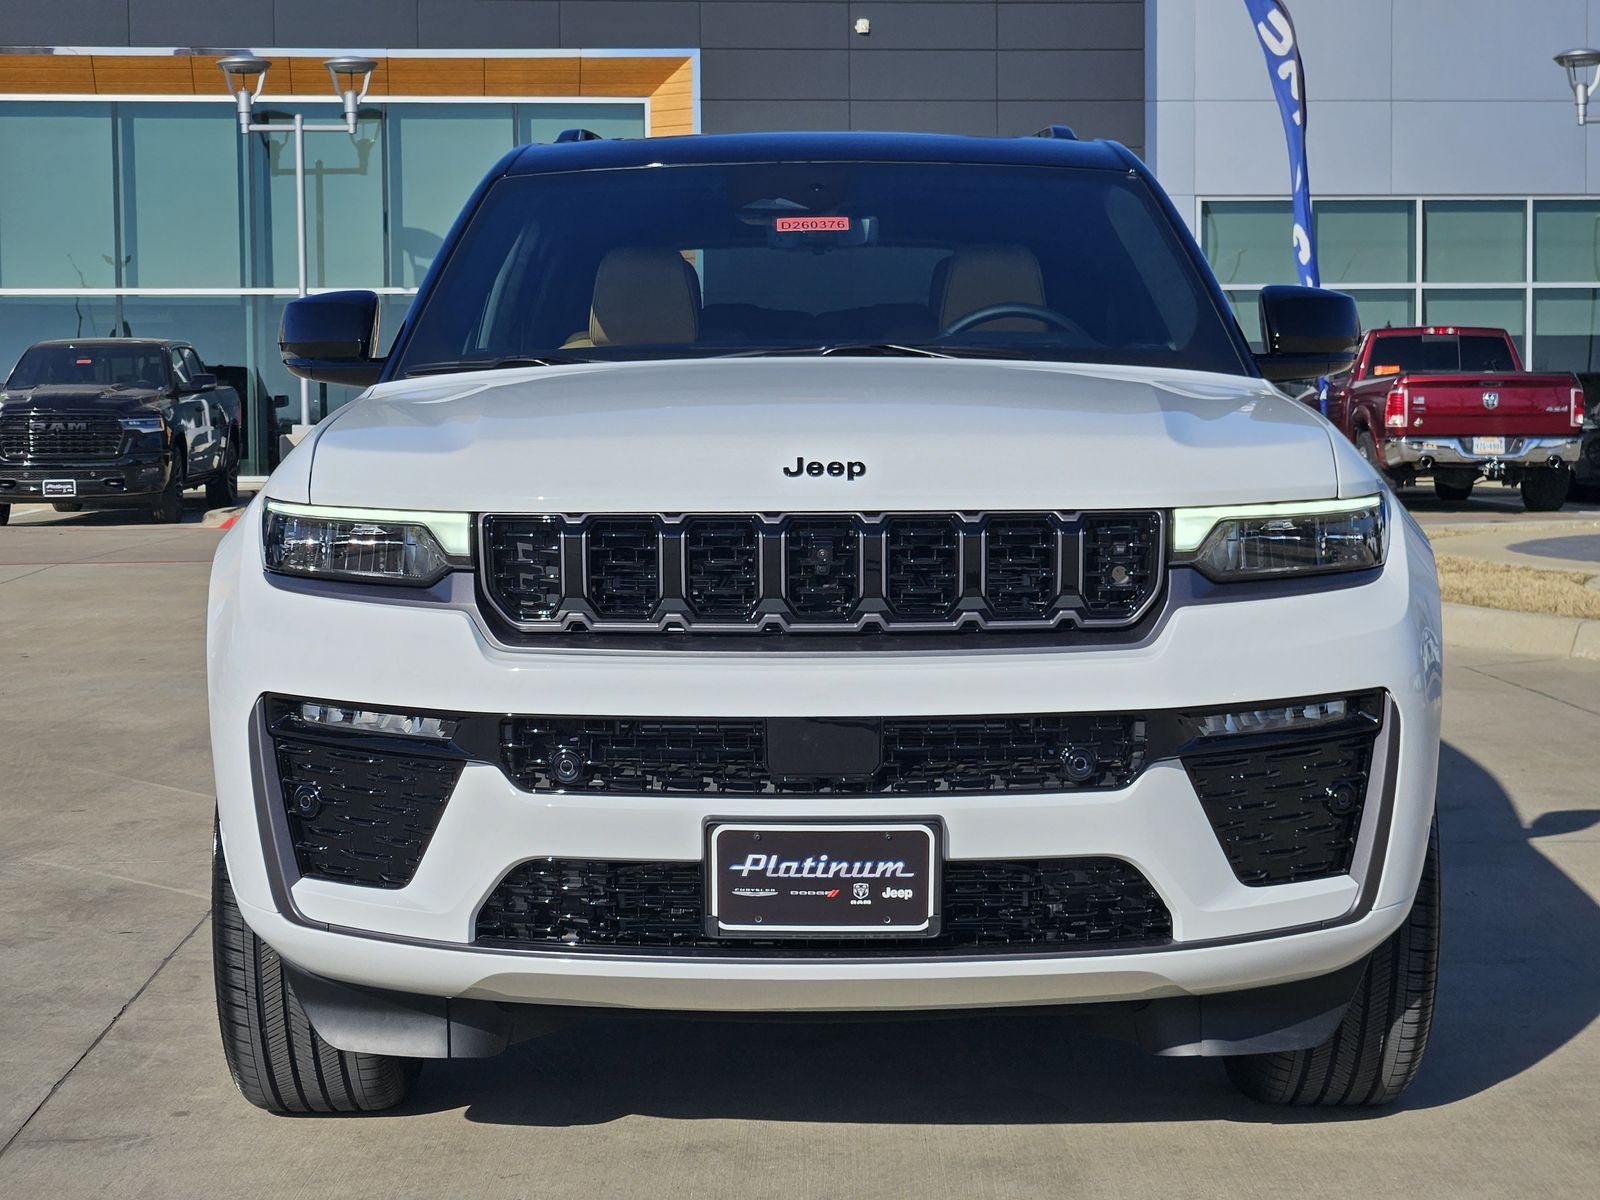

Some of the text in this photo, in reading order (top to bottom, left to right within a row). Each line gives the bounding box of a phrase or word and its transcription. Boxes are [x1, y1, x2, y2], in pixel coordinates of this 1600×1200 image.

[781, 220, 846, 229] D260376
[29, 422, 88, 430] RAM
[783, 456, 867, 481] Jeep
[729, 854, 915, 878] Platinum
[882, 887, 913, 900] Jeep
